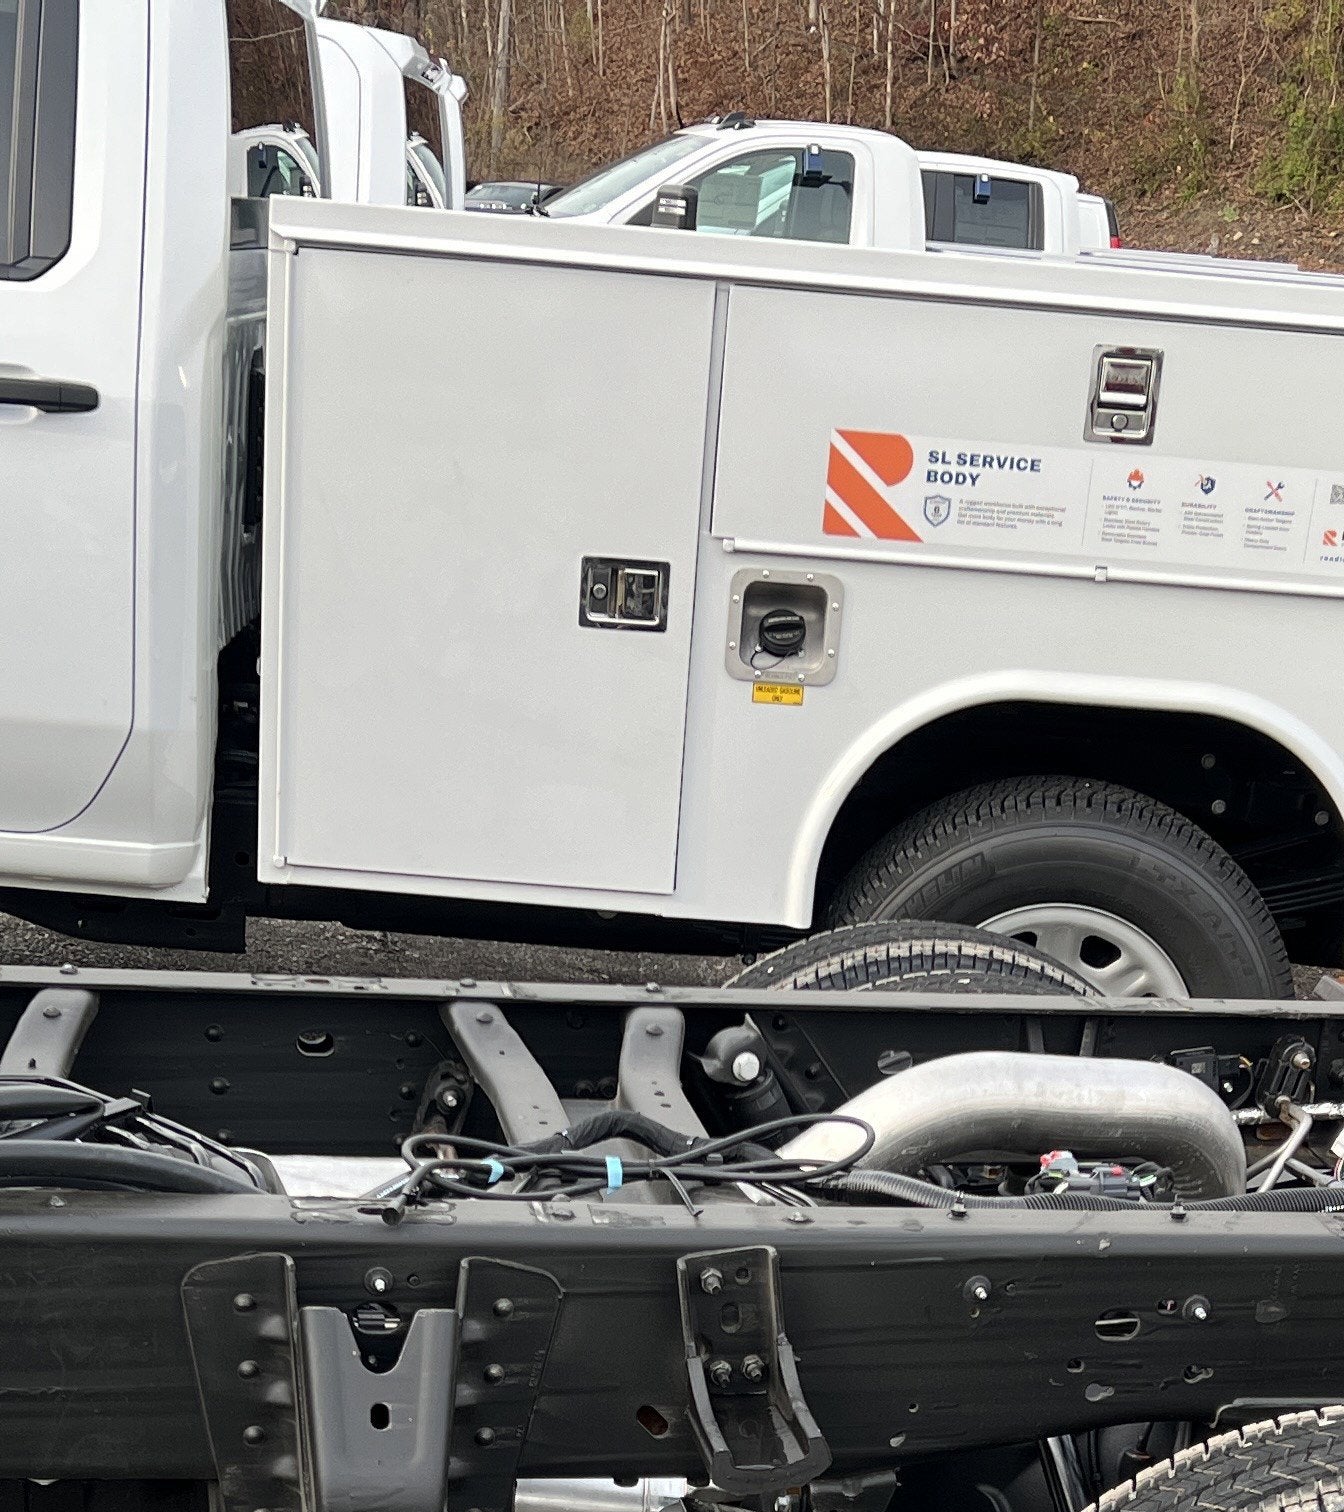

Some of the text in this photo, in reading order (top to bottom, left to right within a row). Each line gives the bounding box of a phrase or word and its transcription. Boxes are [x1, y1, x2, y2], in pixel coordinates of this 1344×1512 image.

[928, 449, 1042, 473] SL SERVICE
[926, 469, 981, 487] BODY
